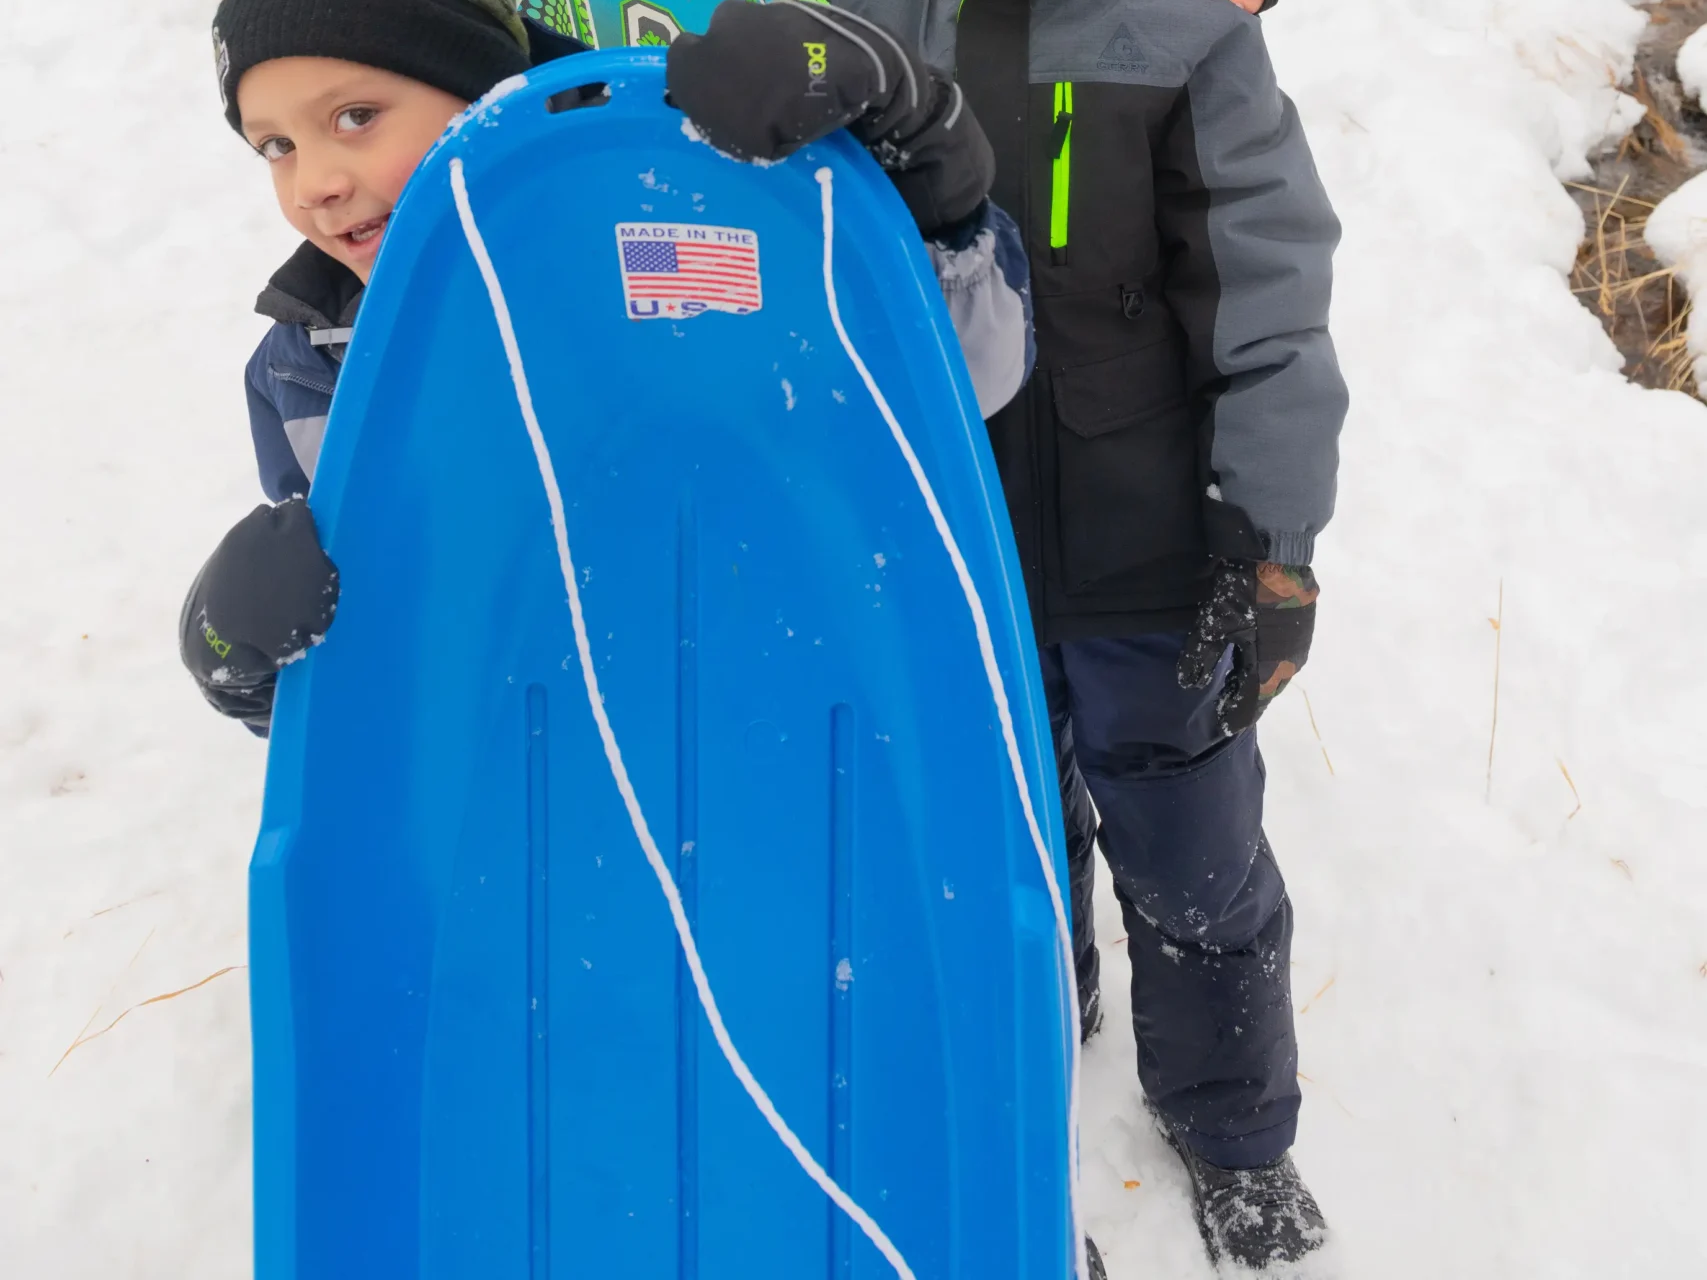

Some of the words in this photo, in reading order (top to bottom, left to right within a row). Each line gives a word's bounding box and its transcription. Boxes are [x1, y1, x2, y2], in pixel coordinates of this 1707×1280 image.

[803, 42, 827, 97] head
[1097, 61, 1149, 73] GERRY
[620, 227, 679, 238] MADE
[687, 229, 706, 240] IN
[714, 231, 753, 245] THE
